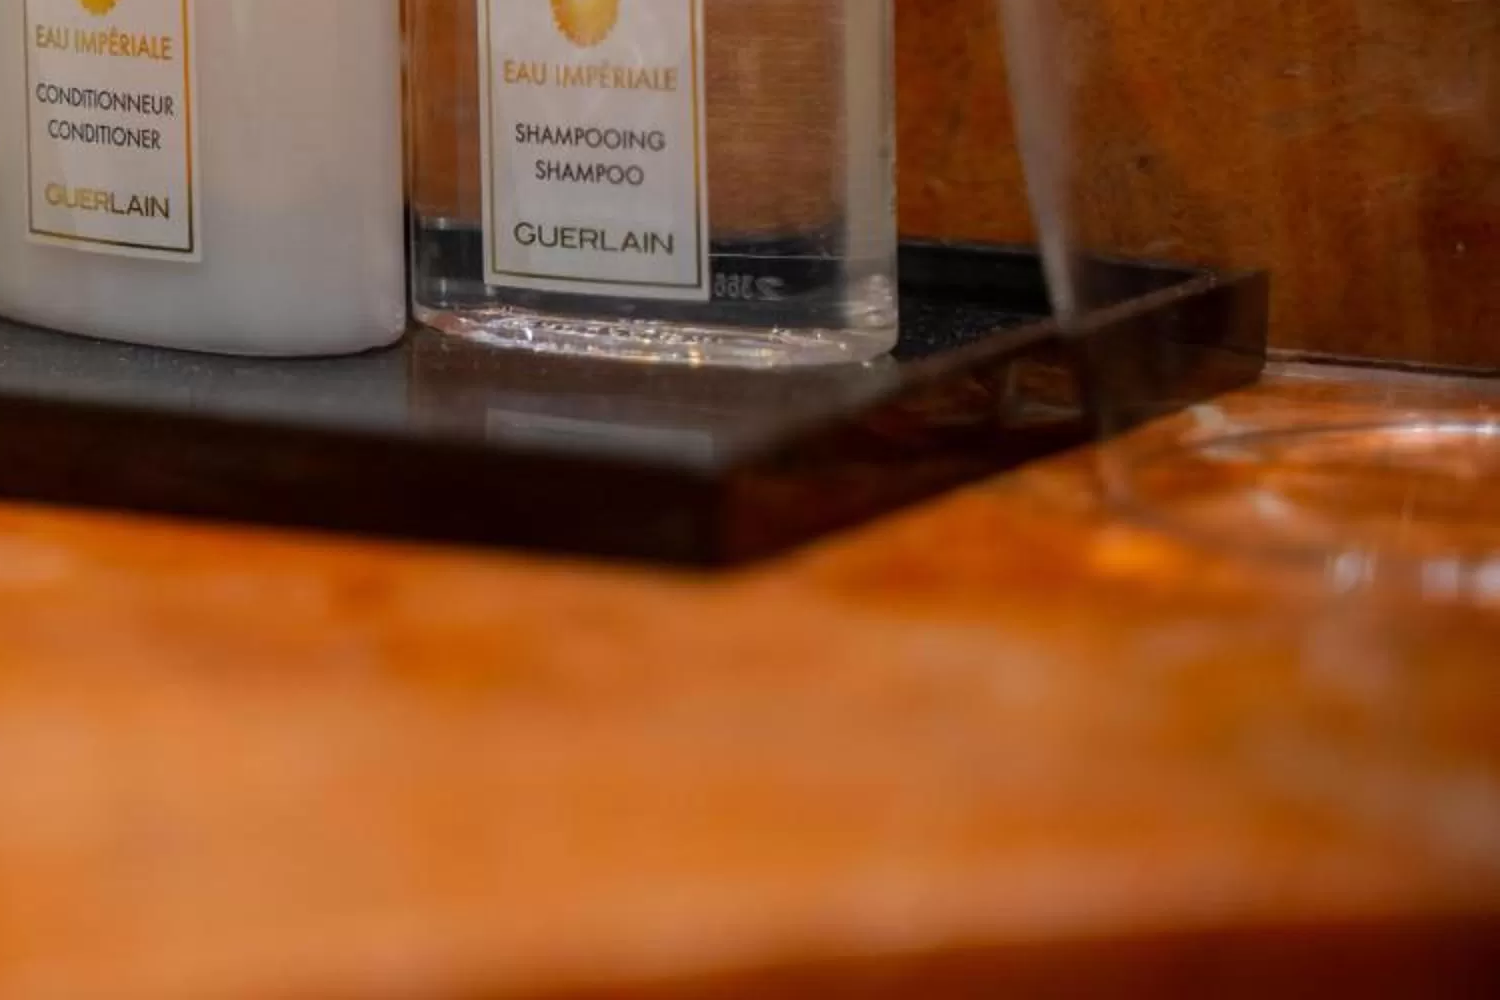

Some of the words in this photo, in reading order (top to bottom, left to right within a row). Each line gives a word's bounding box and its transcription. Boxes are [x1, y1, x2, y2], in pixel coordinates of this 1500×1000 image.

[36, 24, 68, 50] EAU
[74, 25, 172, 60] IMPÉRIALE
[503, 60, 546, 85] EAU
[555, 59, 677, 92] IMPÉRIALE
[36, 83, 174, 116] CONDITIONNEUR
[48, 119, 161, 150] CONDITIONER
[515, 122, 666, 151] SHAMPOOING
[535, 159, 644, 185] SHAMPOO
[45, 182, 170, 219] GUERLAIN
[513, 221, 674, 255] GUERLAIN
